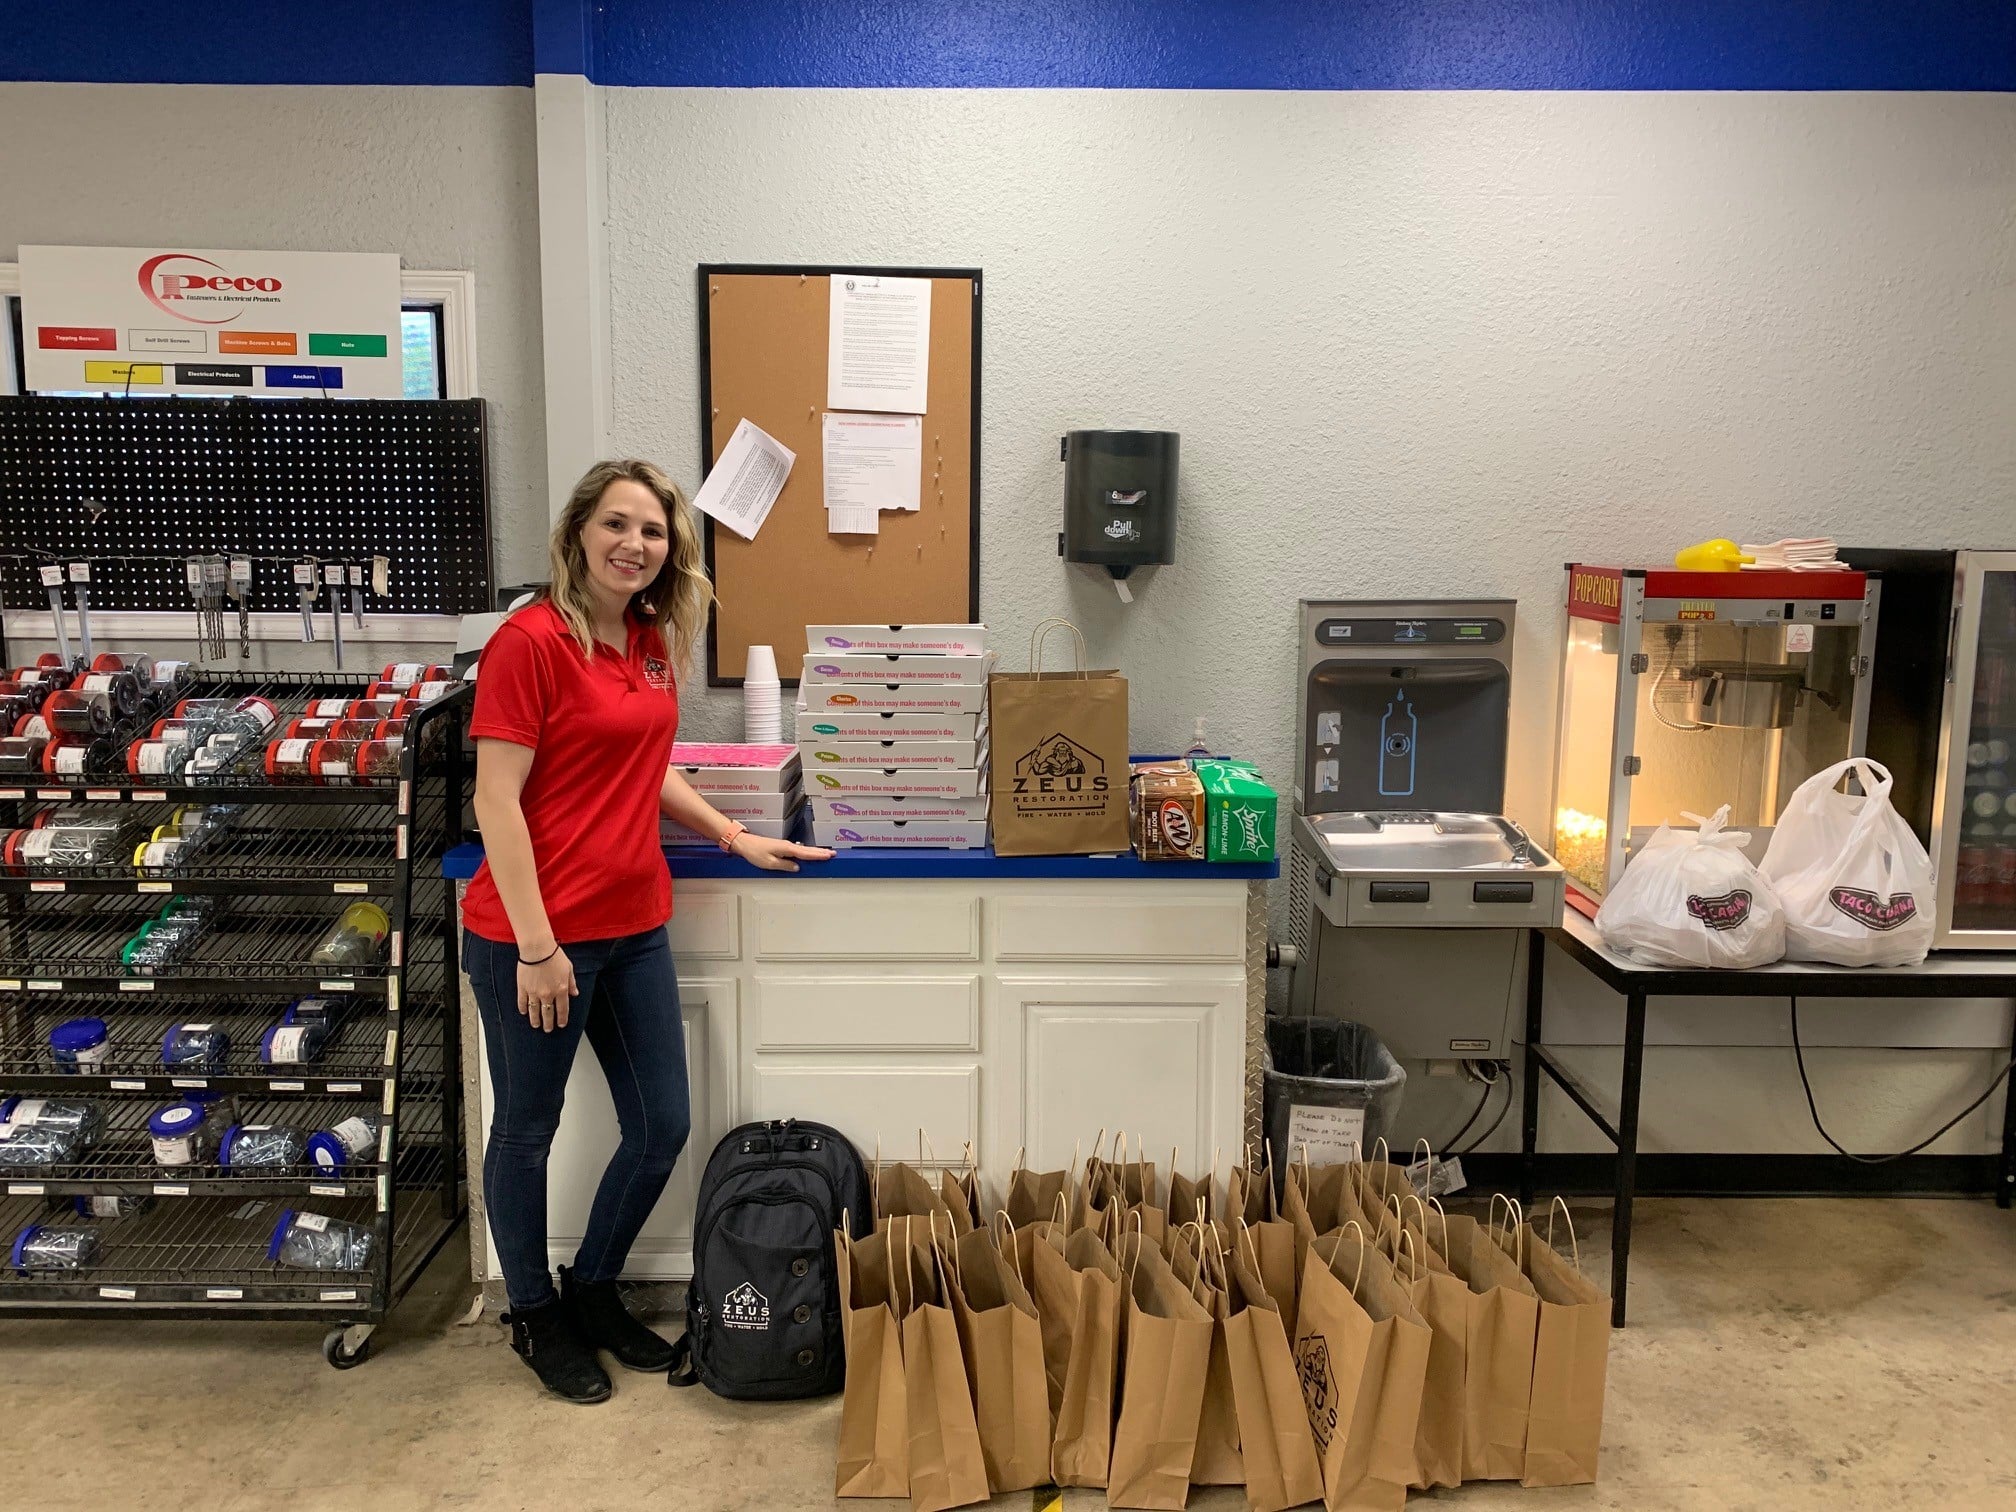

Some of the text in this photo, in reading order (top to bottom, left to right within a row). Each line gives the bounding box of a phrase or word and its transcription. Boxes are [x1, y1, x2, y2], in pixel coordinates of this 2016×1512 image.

[1105, 525, 1129, 534] down
[1114, 520, 1132, 529] Pull
[1574, 573, 1620, 608] POPCORN
[643, 670, 670, 679] ZEU
[1013, 776, 1108, 793] ZEUS
[1013, 794, 1109, 803] RESTORATION
[1242, 809, 1258, 849] Sprite
[1840, 891, 1914, 918] TACO CBANA
[722, 1304, 770, 1316] ZEUS
